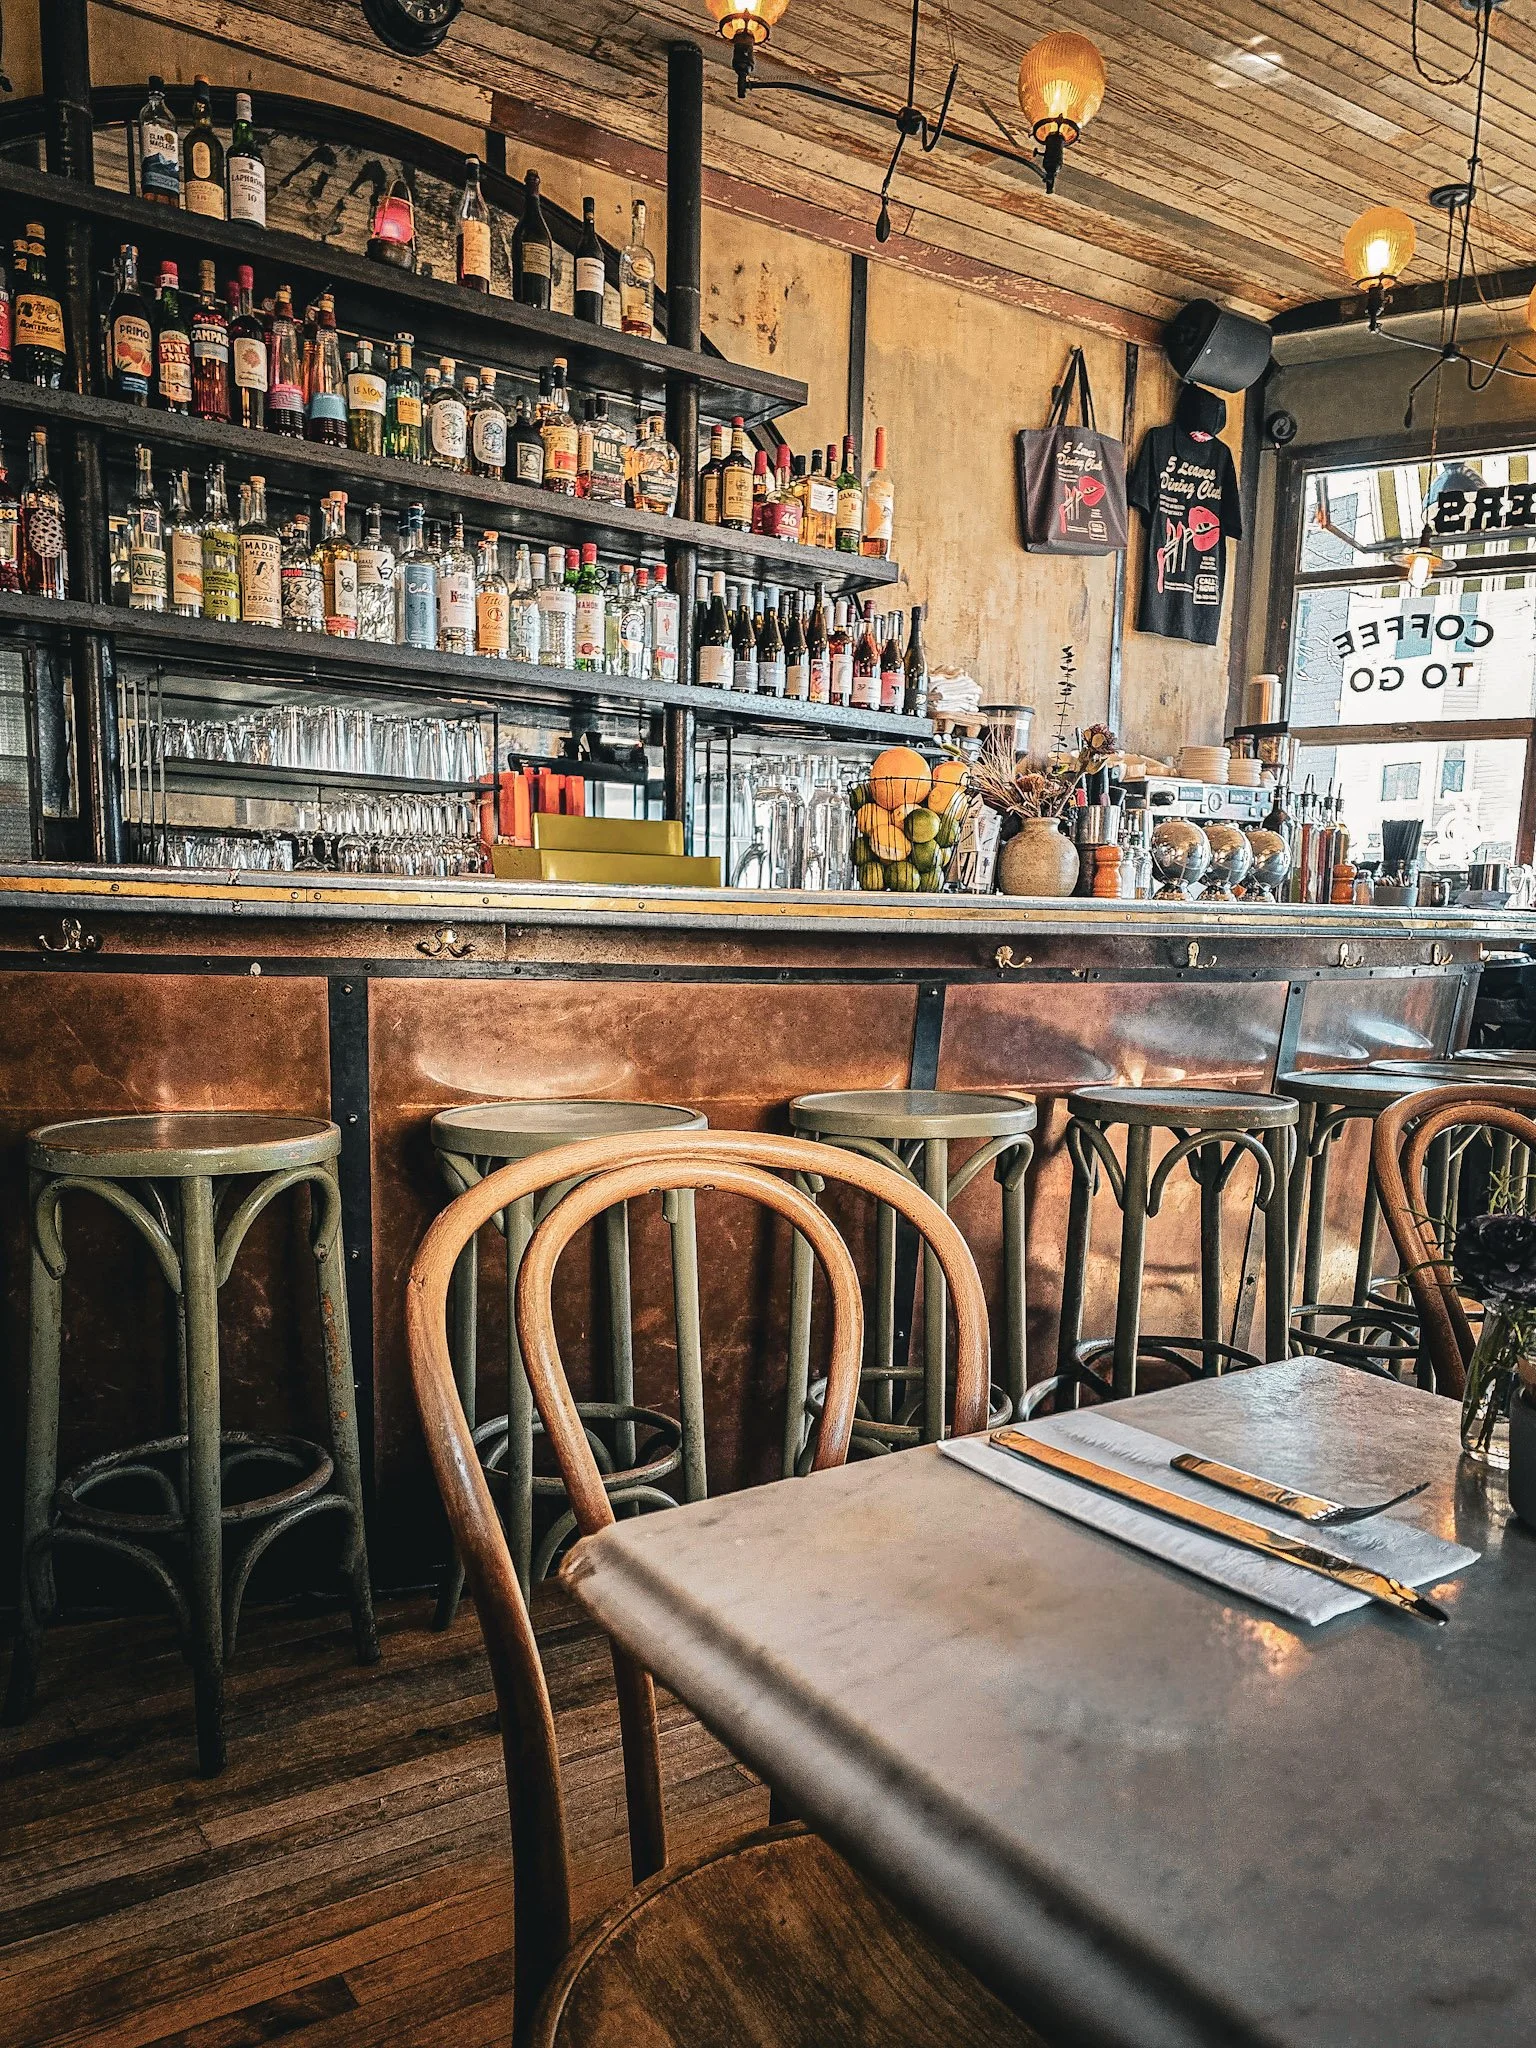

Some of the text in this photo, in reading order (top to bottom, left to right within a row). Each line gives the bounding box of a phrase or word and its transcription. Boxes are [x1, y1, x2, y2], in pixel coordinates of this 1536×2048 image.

[247, 192, 257, 203] 10
[119, 324, 150, 340] PRIMO
[160, 342, 188, 354] PUNT
[168, 352, 191, 364] MES
[593, 439, 618, 458] KNOB
[1062, 441, 1073, 454] 5
[1165, 455, 1217, 481] 5 Leaves
[1159, 471, 1196, 500] Dining
[215, 539, 236, 551] BIEN
[245, 541, 279, 554] MADRE
[1198, 577, 1217, 586] CALL
